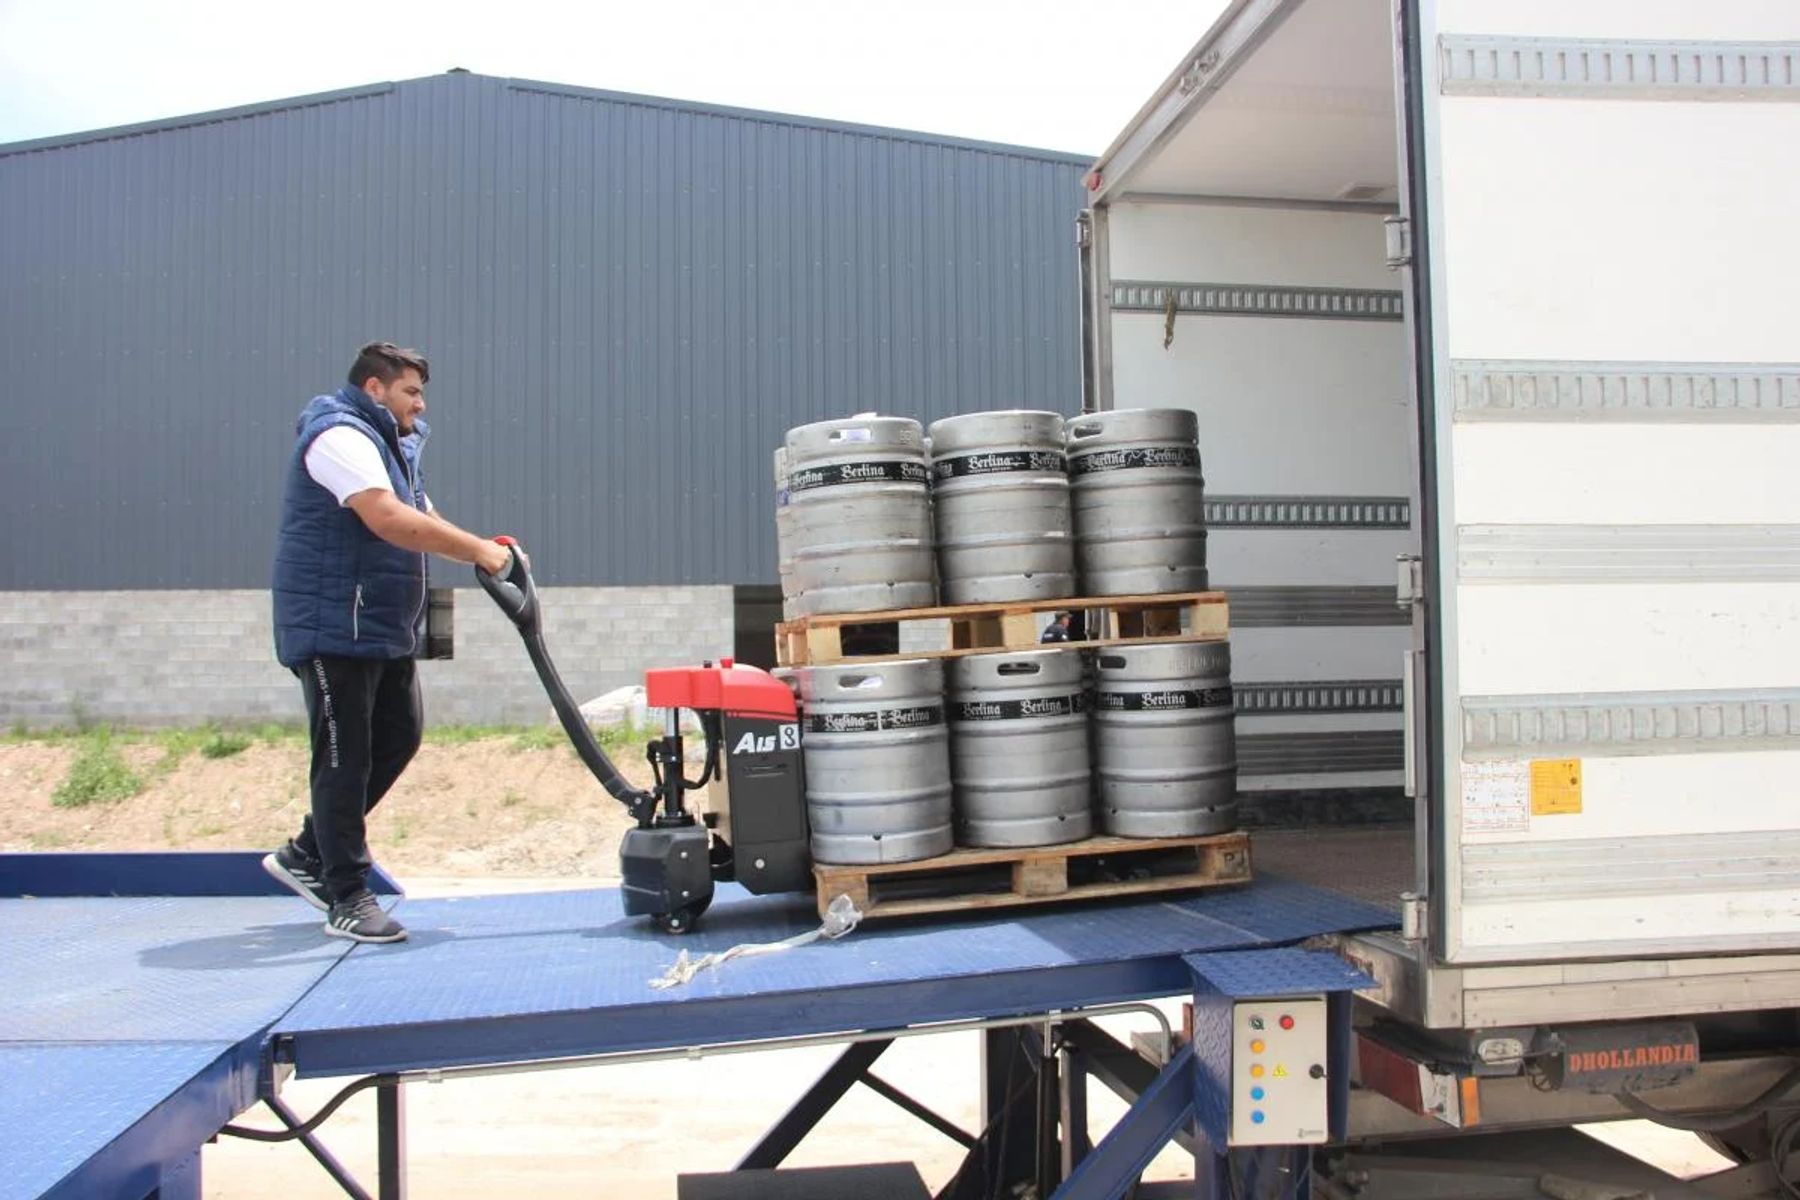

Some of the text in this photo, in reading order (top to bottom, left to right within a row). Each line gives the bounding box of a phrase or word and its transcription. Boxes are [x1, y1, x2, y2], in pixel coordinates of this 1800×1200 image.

[967, 454, 1011, 469] Berlina
[840, 463, 885, 479] Berlina
[1020, 699, 1062, 713] Berlina
[1141, 691, 1186, 706] Berlina
[1569, 1043, 1696, 1072] DHOLLANDIA
